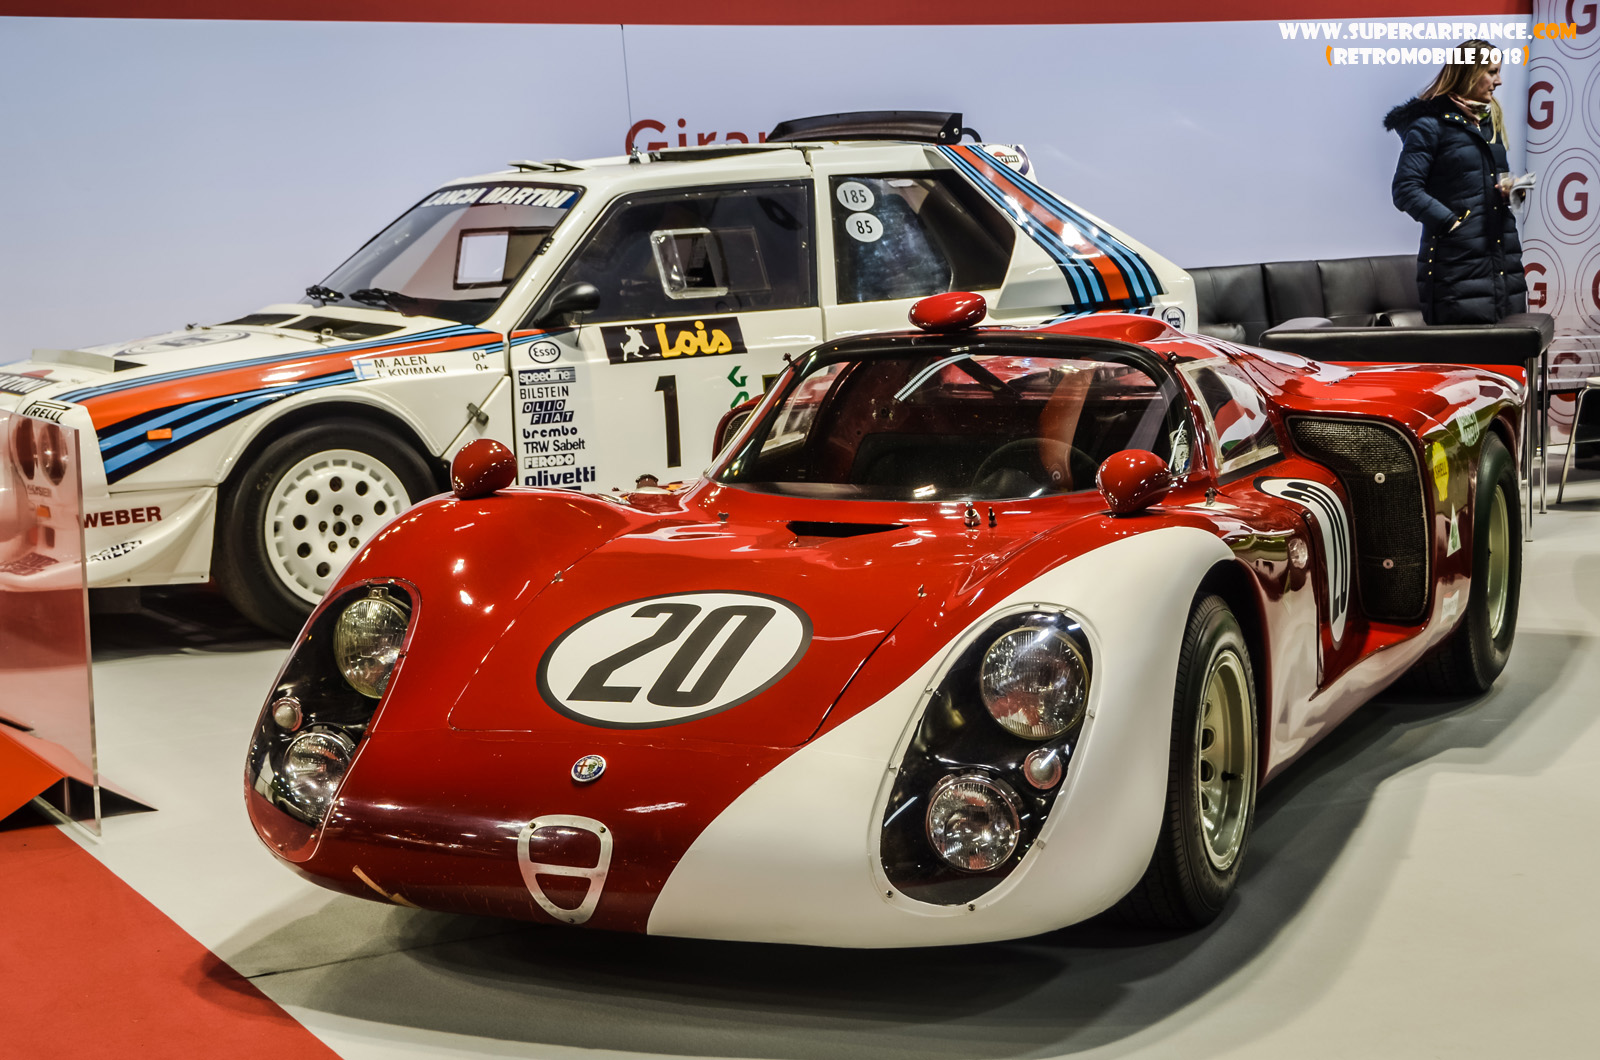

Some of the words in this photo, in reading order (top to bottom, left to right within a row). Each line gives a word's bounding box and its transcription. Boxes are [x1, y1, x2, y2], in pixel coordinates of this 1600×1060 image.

[1527, 80, 1554, 130] G
[420, 187, 487, 208] LANCIA
[479, 186, 575, 208] MARTINI
[843, 189, 867, 204] 185
[1557, 171, 1589, 222] G
[856, 220, 873, 235] 85
[654, 320, 733, 359] Lois
[374, 359, 390, 369] M.
[393, 355, 428, 367] ALEN
[519, 385, 569, 400] BILSTEIN
[524, 400, 565, 412] OLIO
[532, 411, 572, 424] FIAT
[654, 375, 682, 468] 1
[522, 425, 578, 439] brembo
[523, 440, 549, 454] TRW
[553, 437, 586, 452] Sabelt
[525, 453, 574, 468] FERODO
[525, 465, 596, 487] olivetti
[82, 505, 163, 529] WEBER
[565, 602, 777, 708] 20
